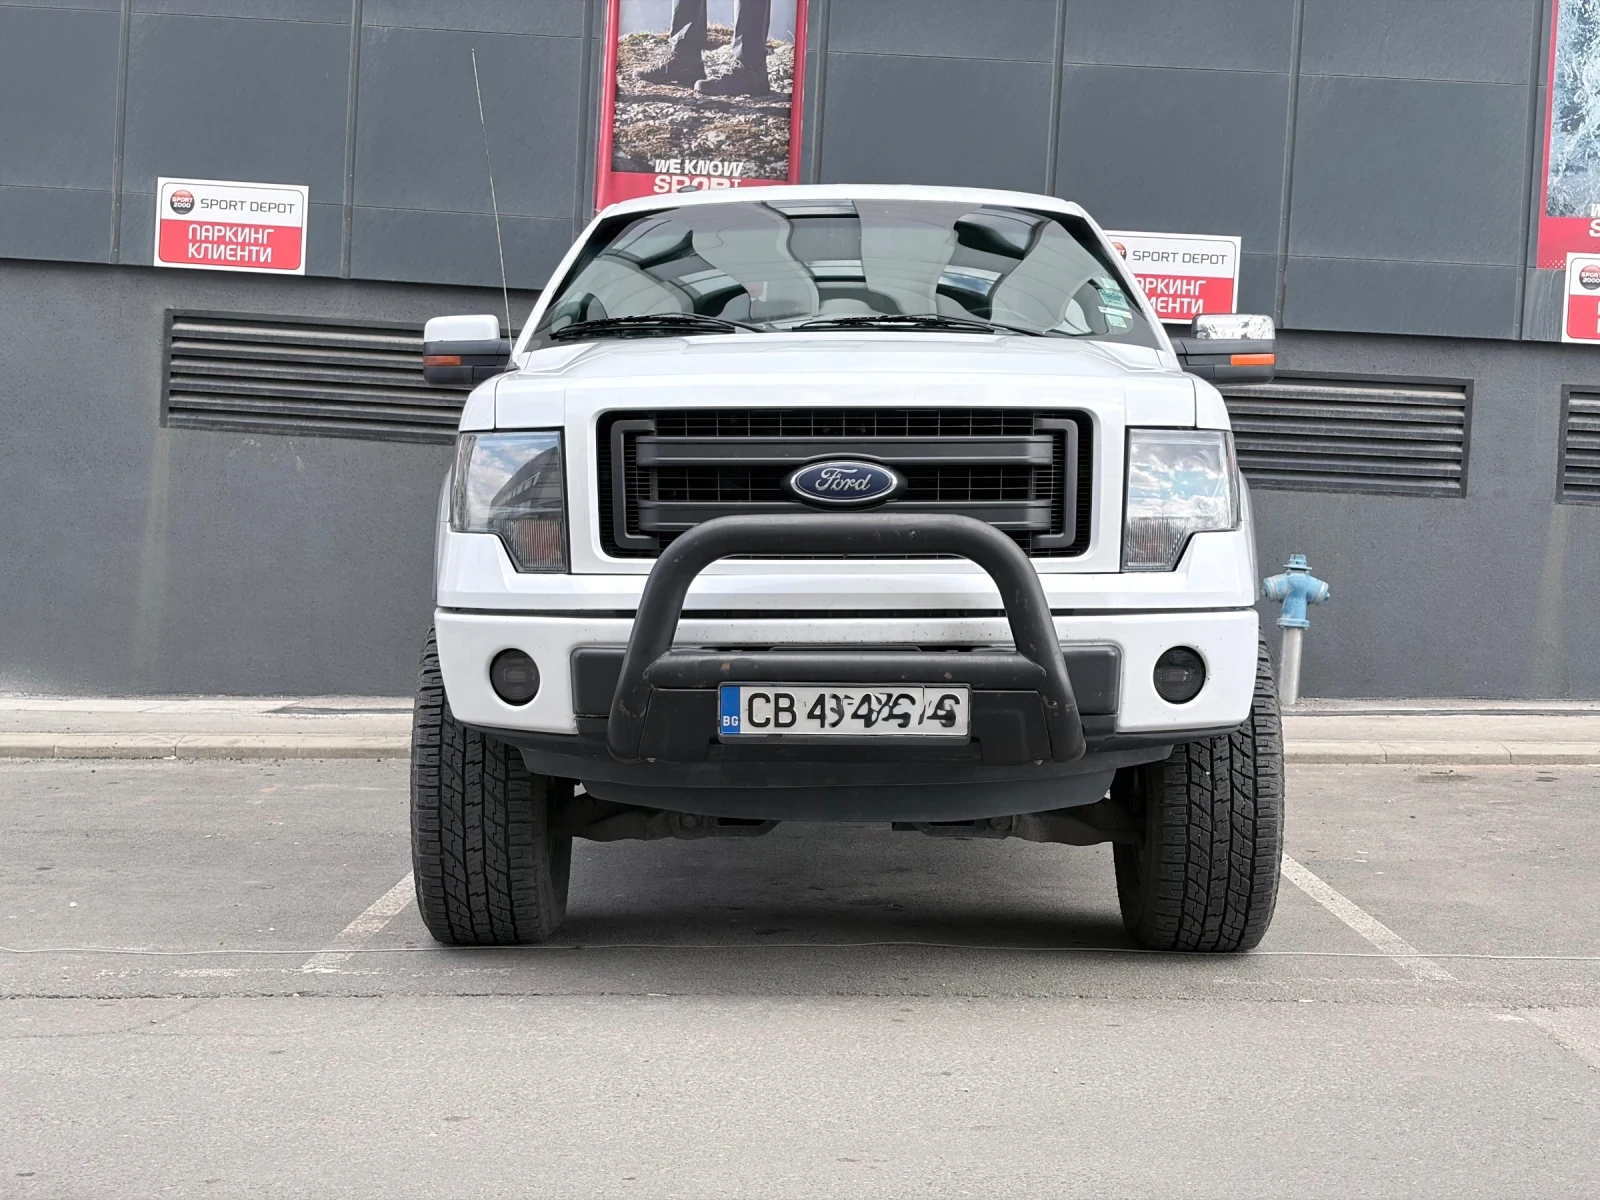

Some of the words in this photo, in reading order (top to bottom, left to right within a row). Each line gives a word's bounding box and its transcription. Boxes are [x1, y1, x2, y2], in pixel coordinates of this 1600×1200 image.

[655, 159, 681, 174] WE
[684, 160, 744, 177] KNOW
[200, 198, 246, 211] SPORT
[250, 201, 295, 214] DEPOT
[188, 224, 274, 244] ПАРКИНГ
[188, 242, 272, 263] КЛИЕНТИ
[1132, 250, 1179, 263] SPORT
[1182, 253, 1227, 265] DEPOT
[815, 467, 872, 491] Ford
[722, 715, 739, 727] BG
